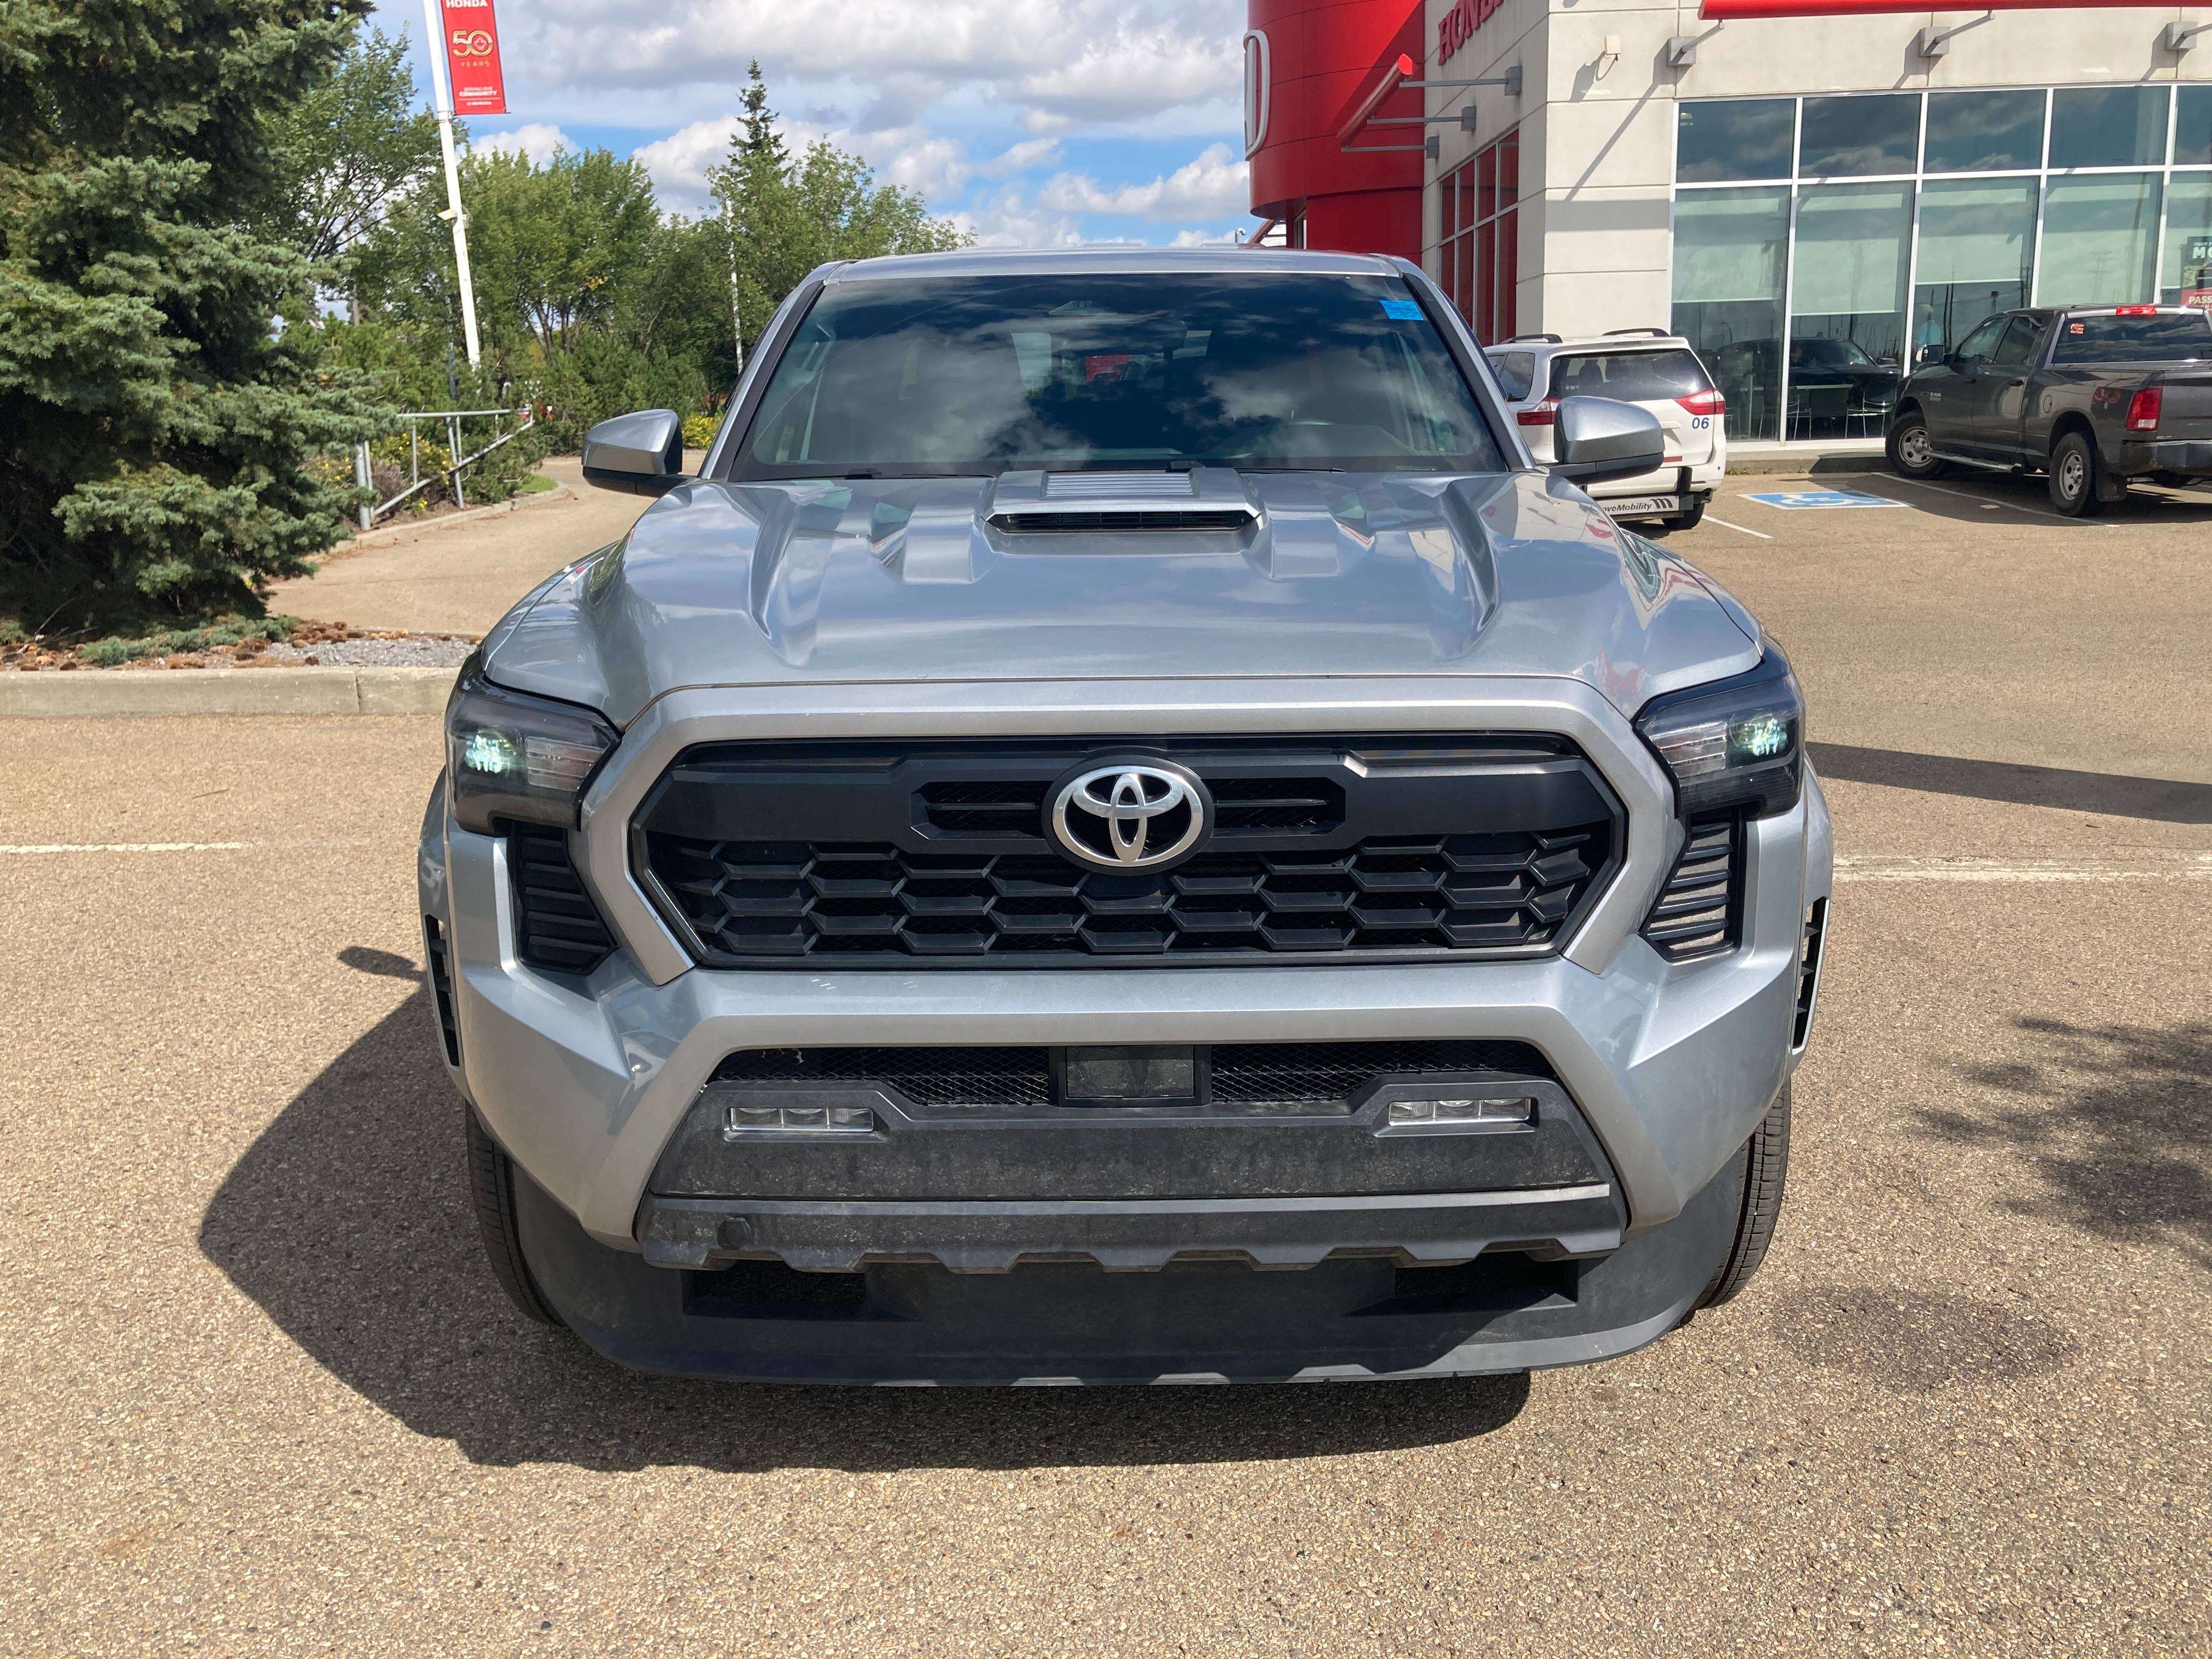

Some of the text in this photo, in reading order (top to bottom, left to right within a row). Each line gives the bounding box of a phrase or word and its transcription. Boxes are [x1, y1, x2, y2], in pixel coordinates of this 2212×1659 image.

[446, 0, 489, 8] HONDA
[1437, 0, 1504, 66] HON
[452, 29, 494, 58] 50
[2188, 295, 2212, 304] PASS
[1692, 417, 1709, 430] 06
[1602, 502, 1652, 514] oveMobility
